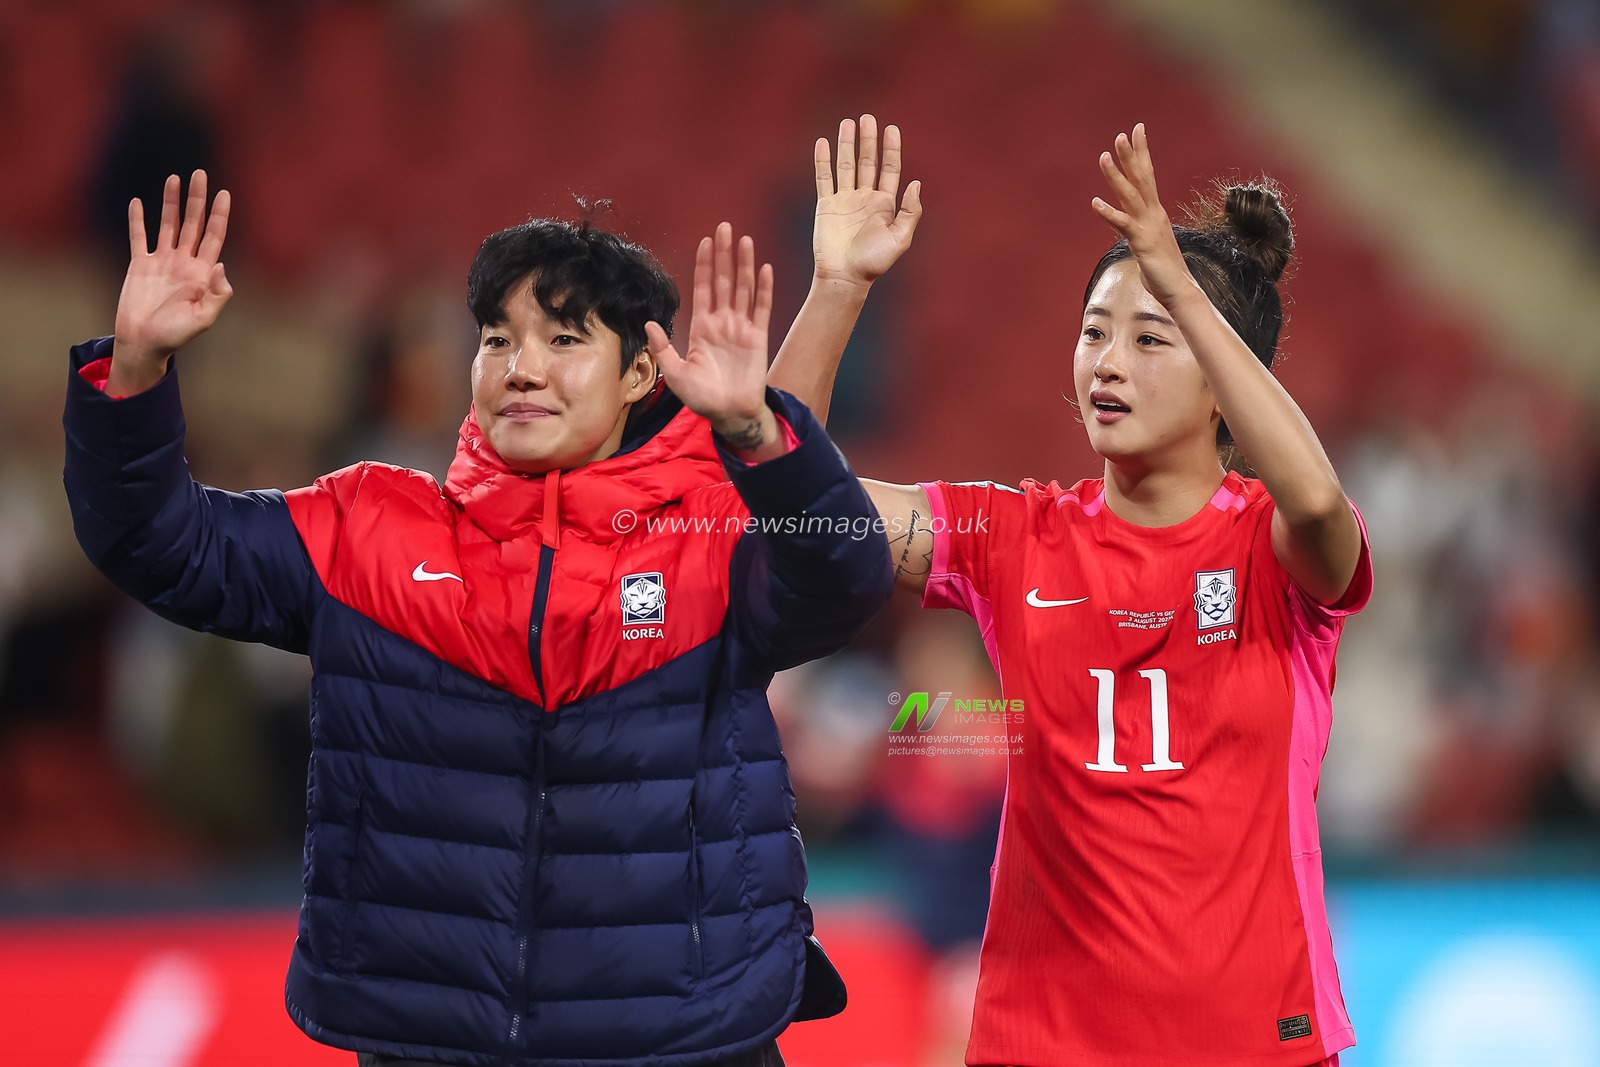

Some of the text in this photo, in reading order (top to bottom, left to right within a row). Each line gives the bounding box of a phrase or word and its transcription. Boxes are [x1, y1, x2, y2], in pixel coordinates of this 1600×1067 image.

[1129, 611, 1155, 619] REPUBLIC
[1118, 621, 1148, 630] BRISBANE,
[622, 627, 664, 641] KOREA
[1197, 629, 1237, 646] KOREA
[1084, 668, 1186, 773] 11
